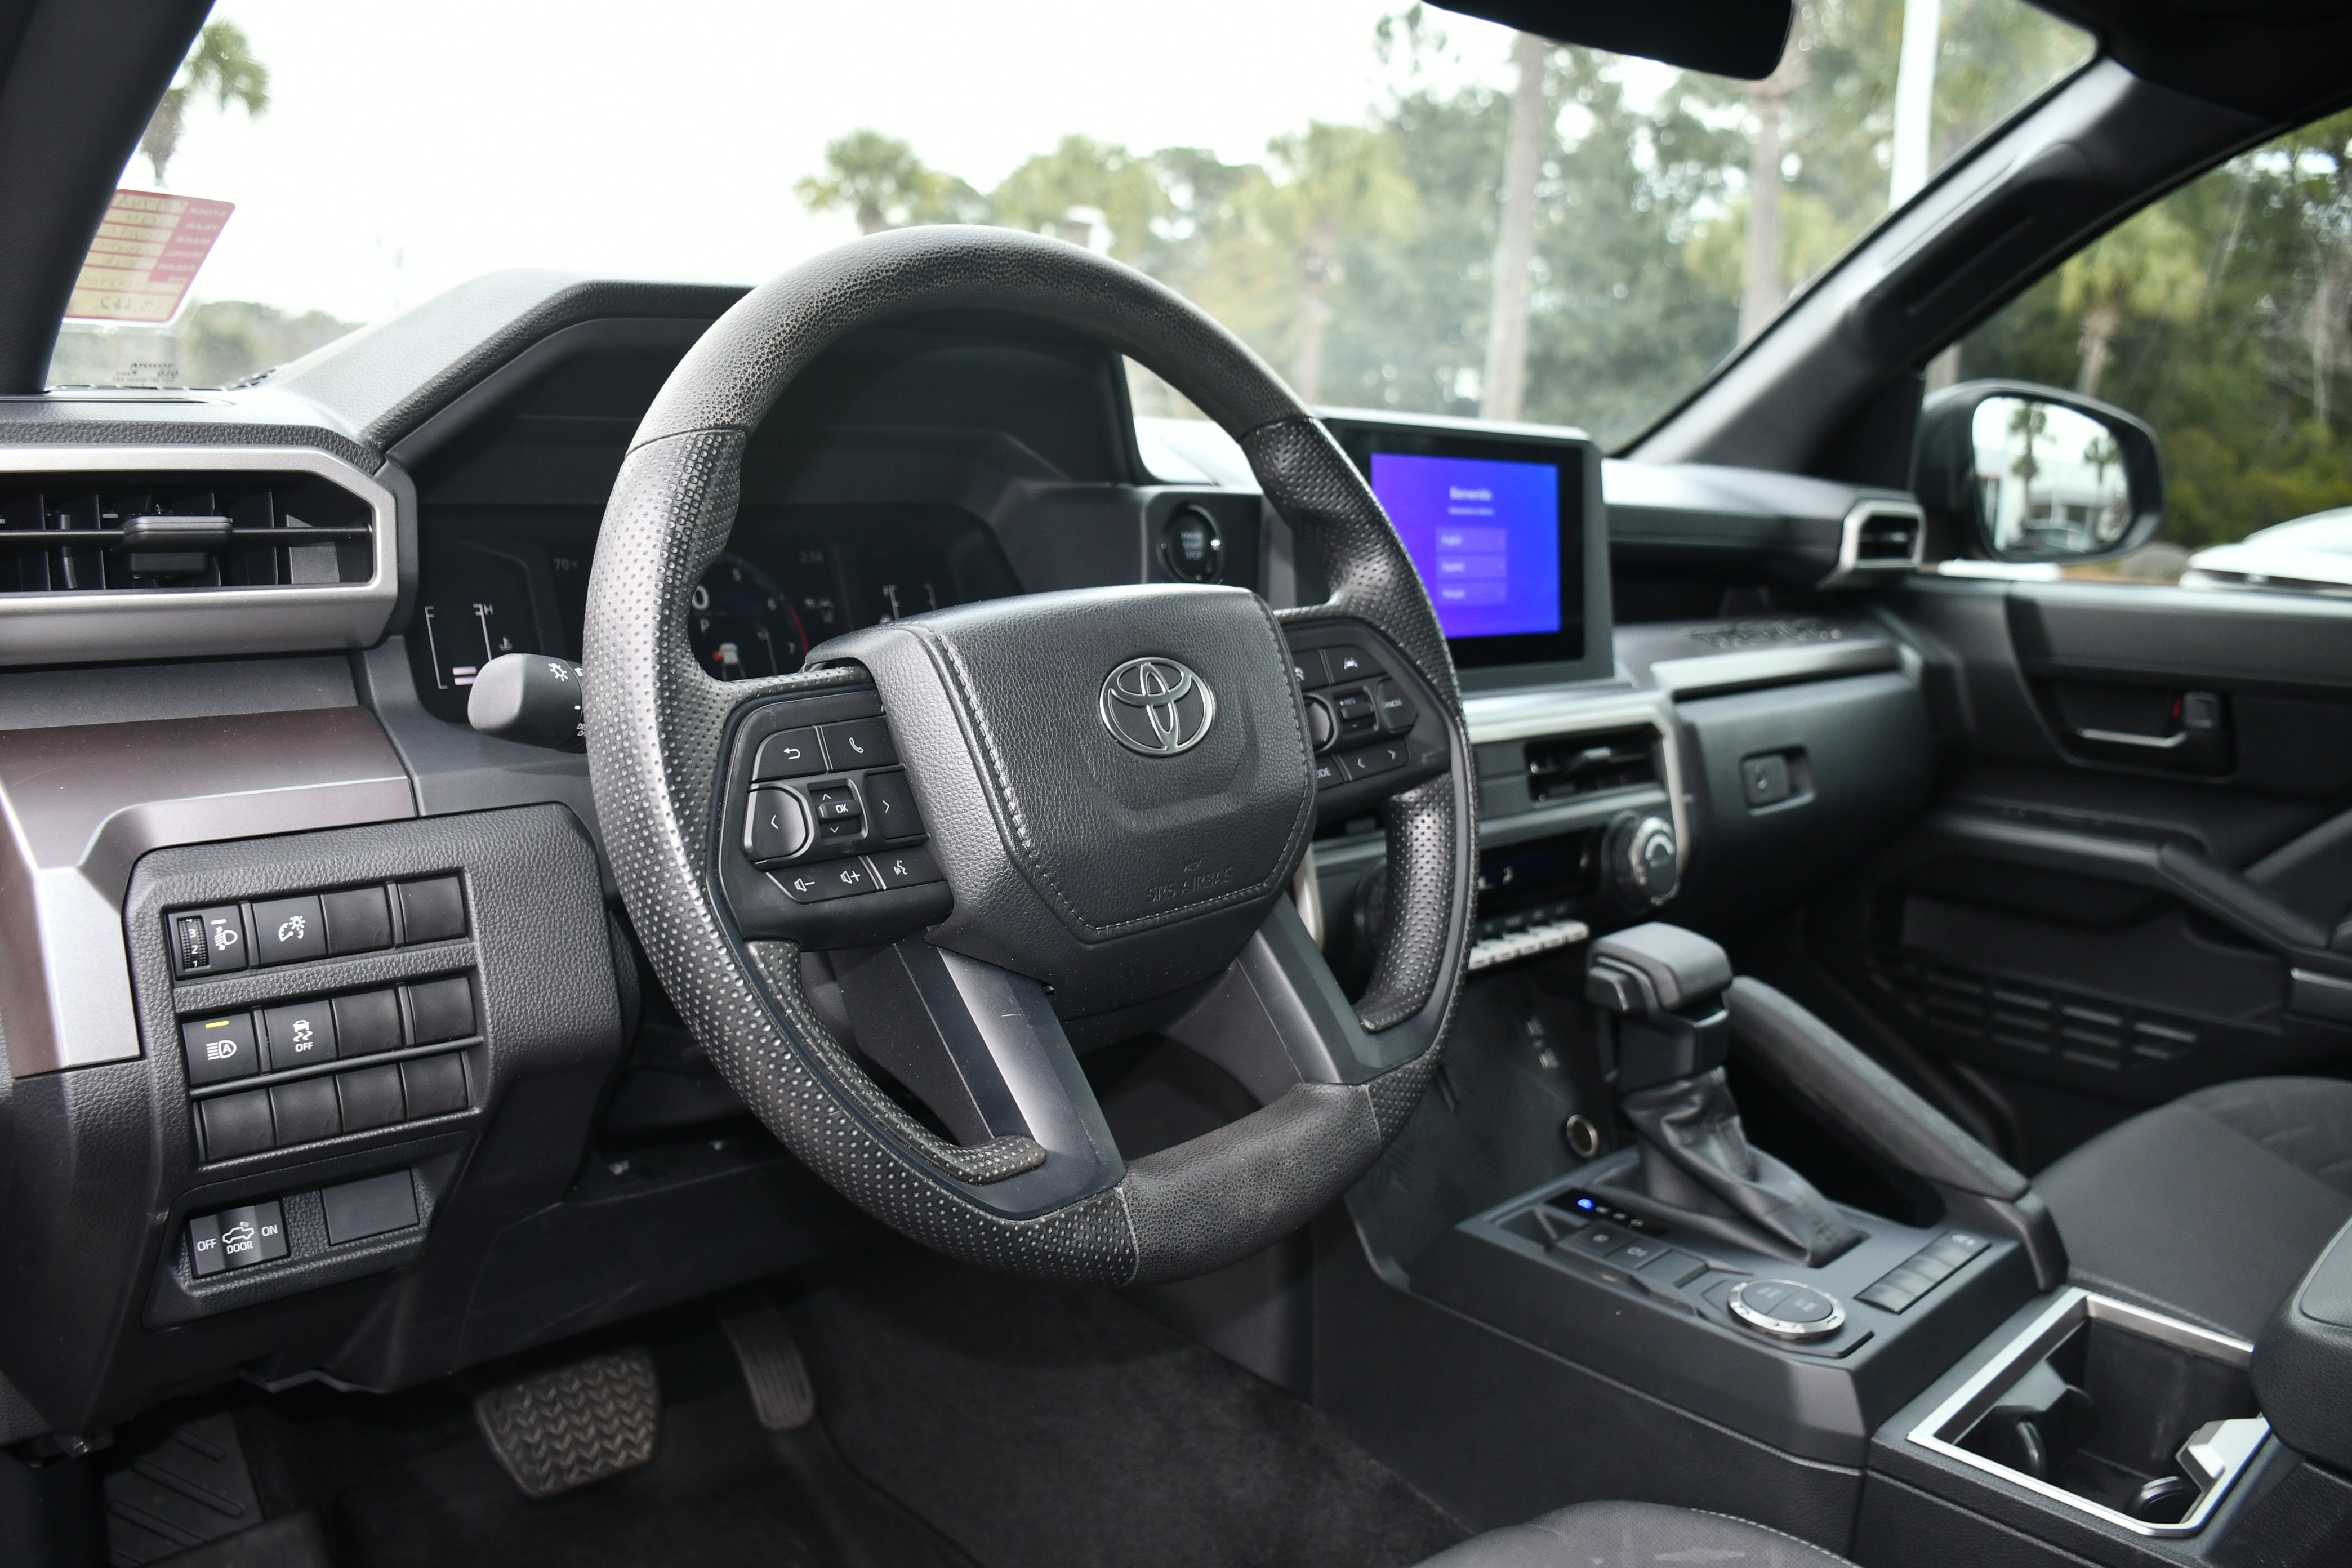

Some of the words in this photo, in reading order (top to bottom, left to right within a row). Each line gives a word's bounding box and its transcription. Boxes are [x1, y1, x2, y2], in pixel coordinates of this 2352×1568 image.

[700, 618, 710, 633] P
[835, 804, 849, 814] OK
[188, 928, 197, 938] 3
[191, 945, 199, 954] 2
[295, 1041, 313, 1052] OFF
[261, 1224, 278, 1236] ON
[197, 1238, 216, 1251] OFF
[226, 1241, 253, 1254] DOOR
